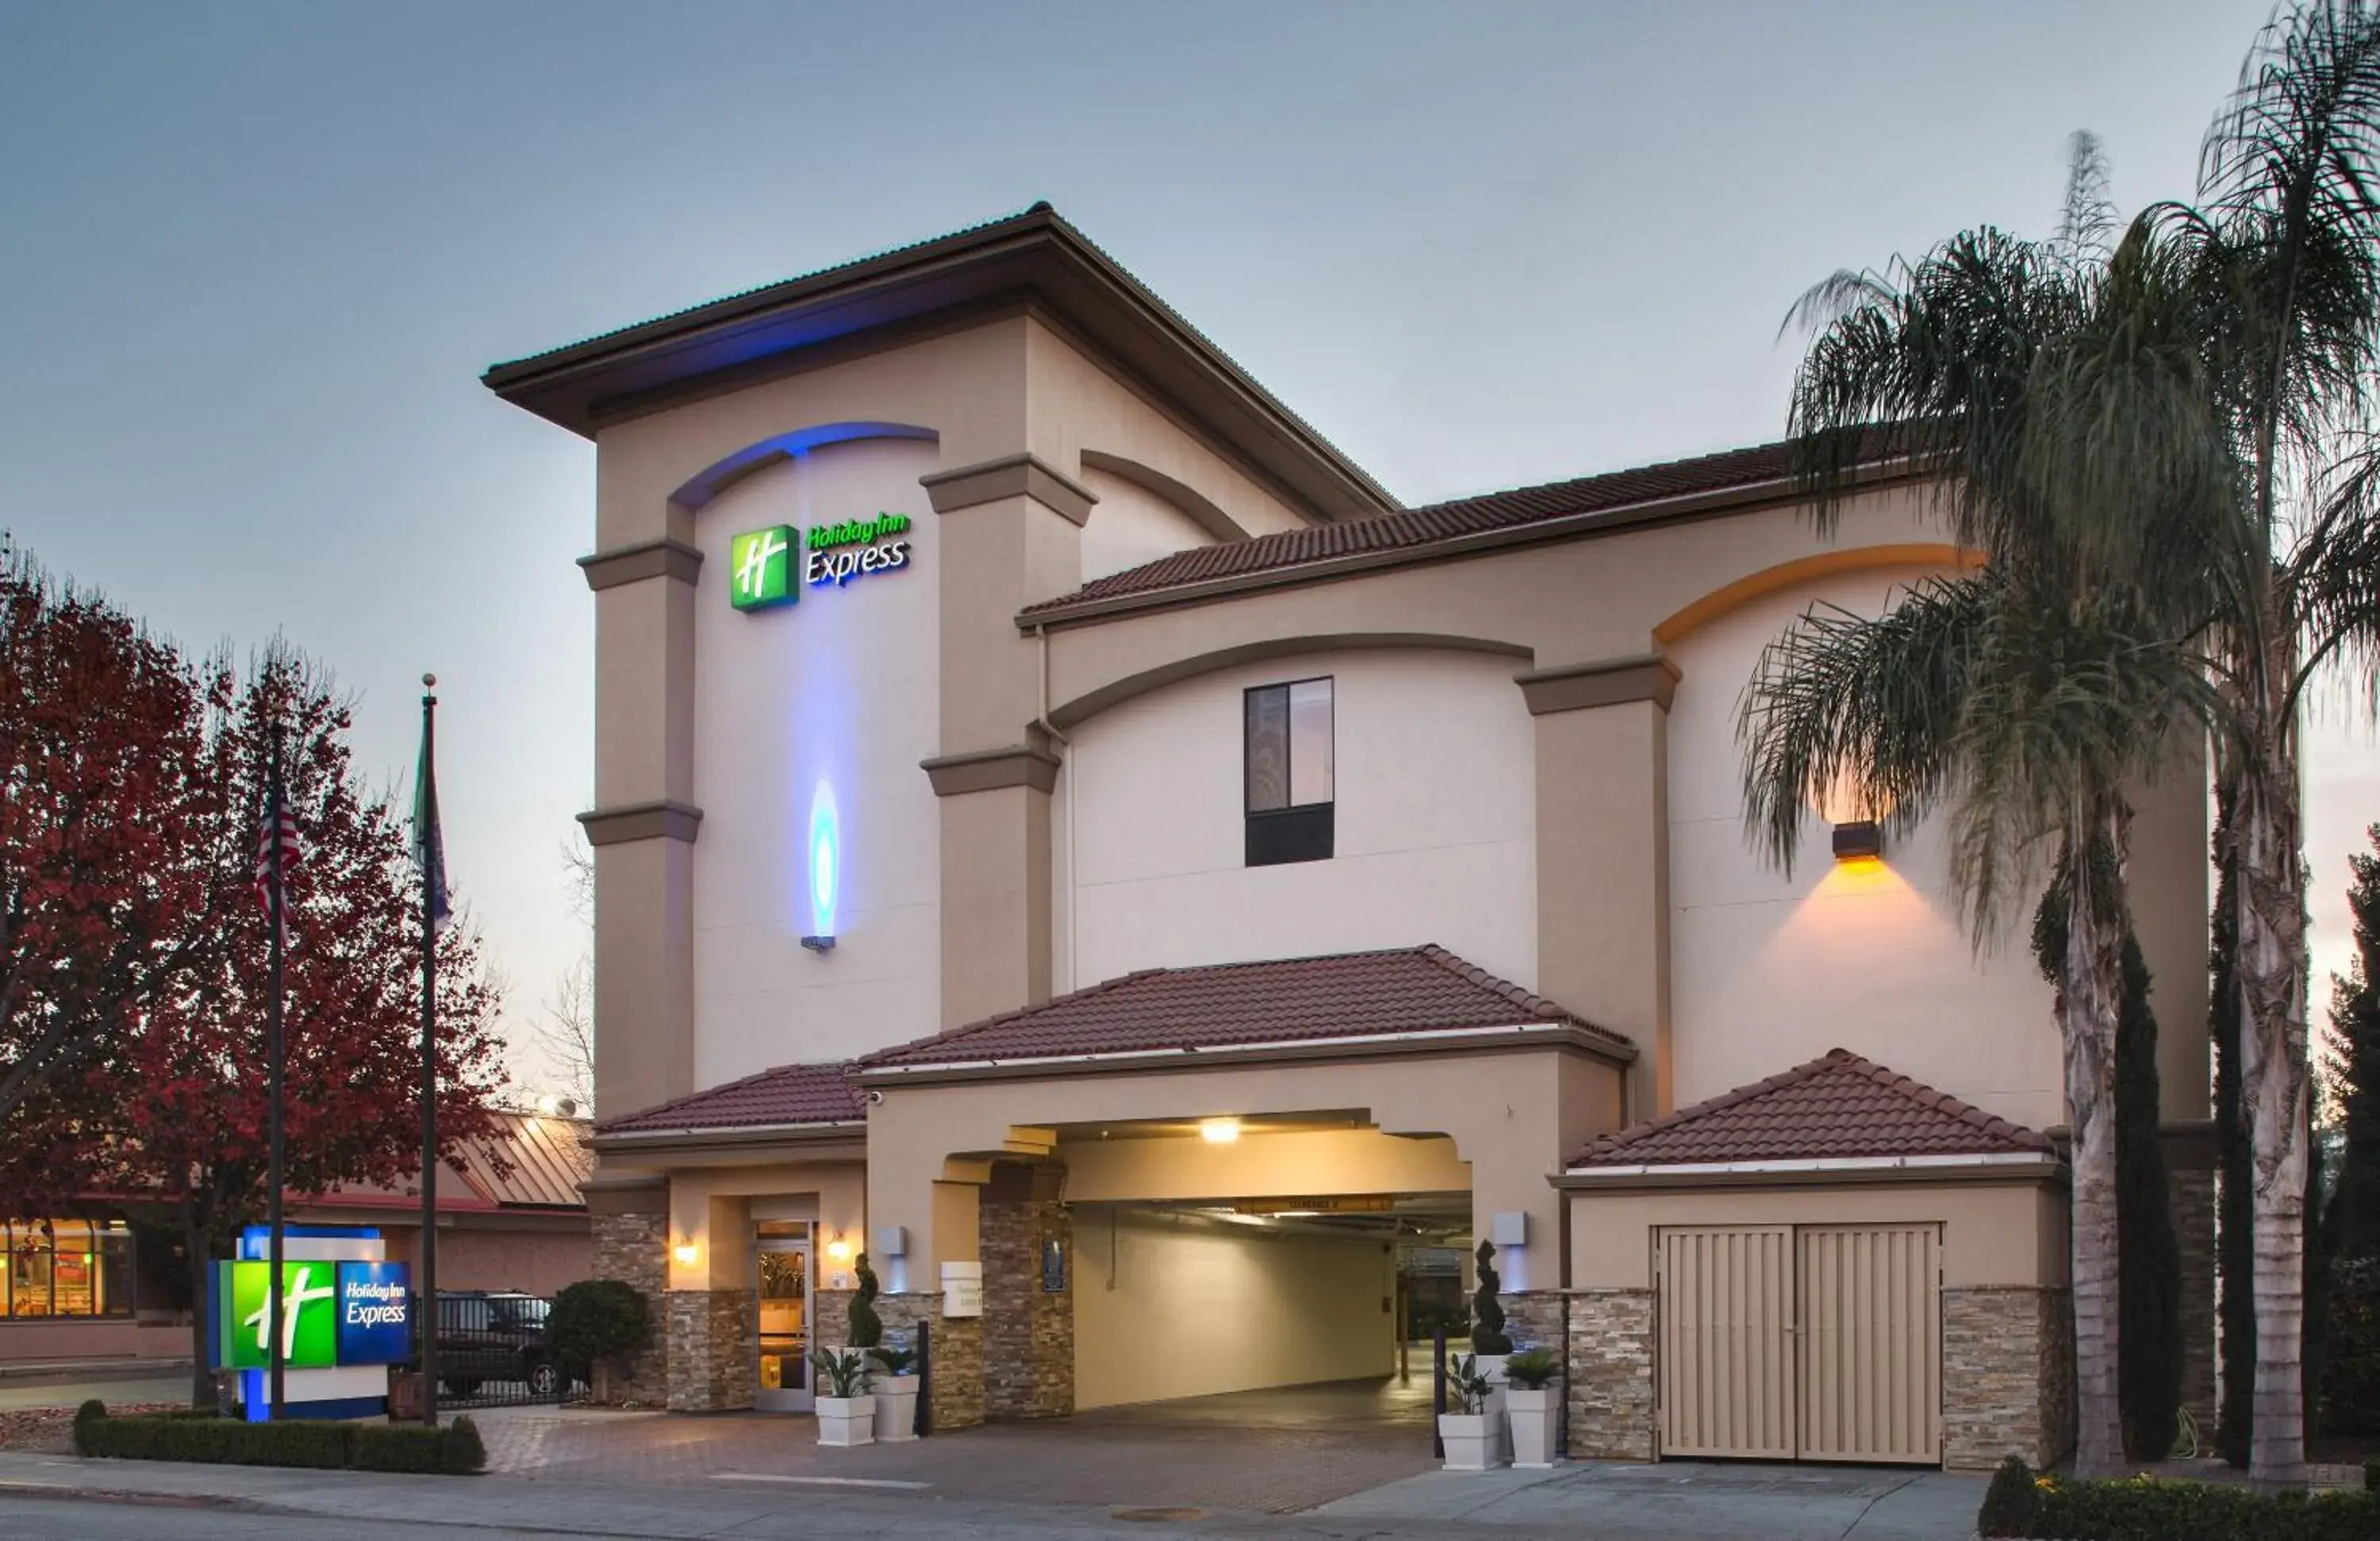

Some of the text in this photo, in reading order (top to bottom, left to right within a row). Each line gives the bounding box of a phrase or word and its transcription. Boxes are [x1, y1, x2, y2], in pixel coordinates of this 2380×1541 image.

[805, 510, 908, 549] Holiday Inn
[805, 541, 906, 586] Express
[346, 1282, 405, 1301] Holiday Inn
[347, 1302, 406, 1329] Express
